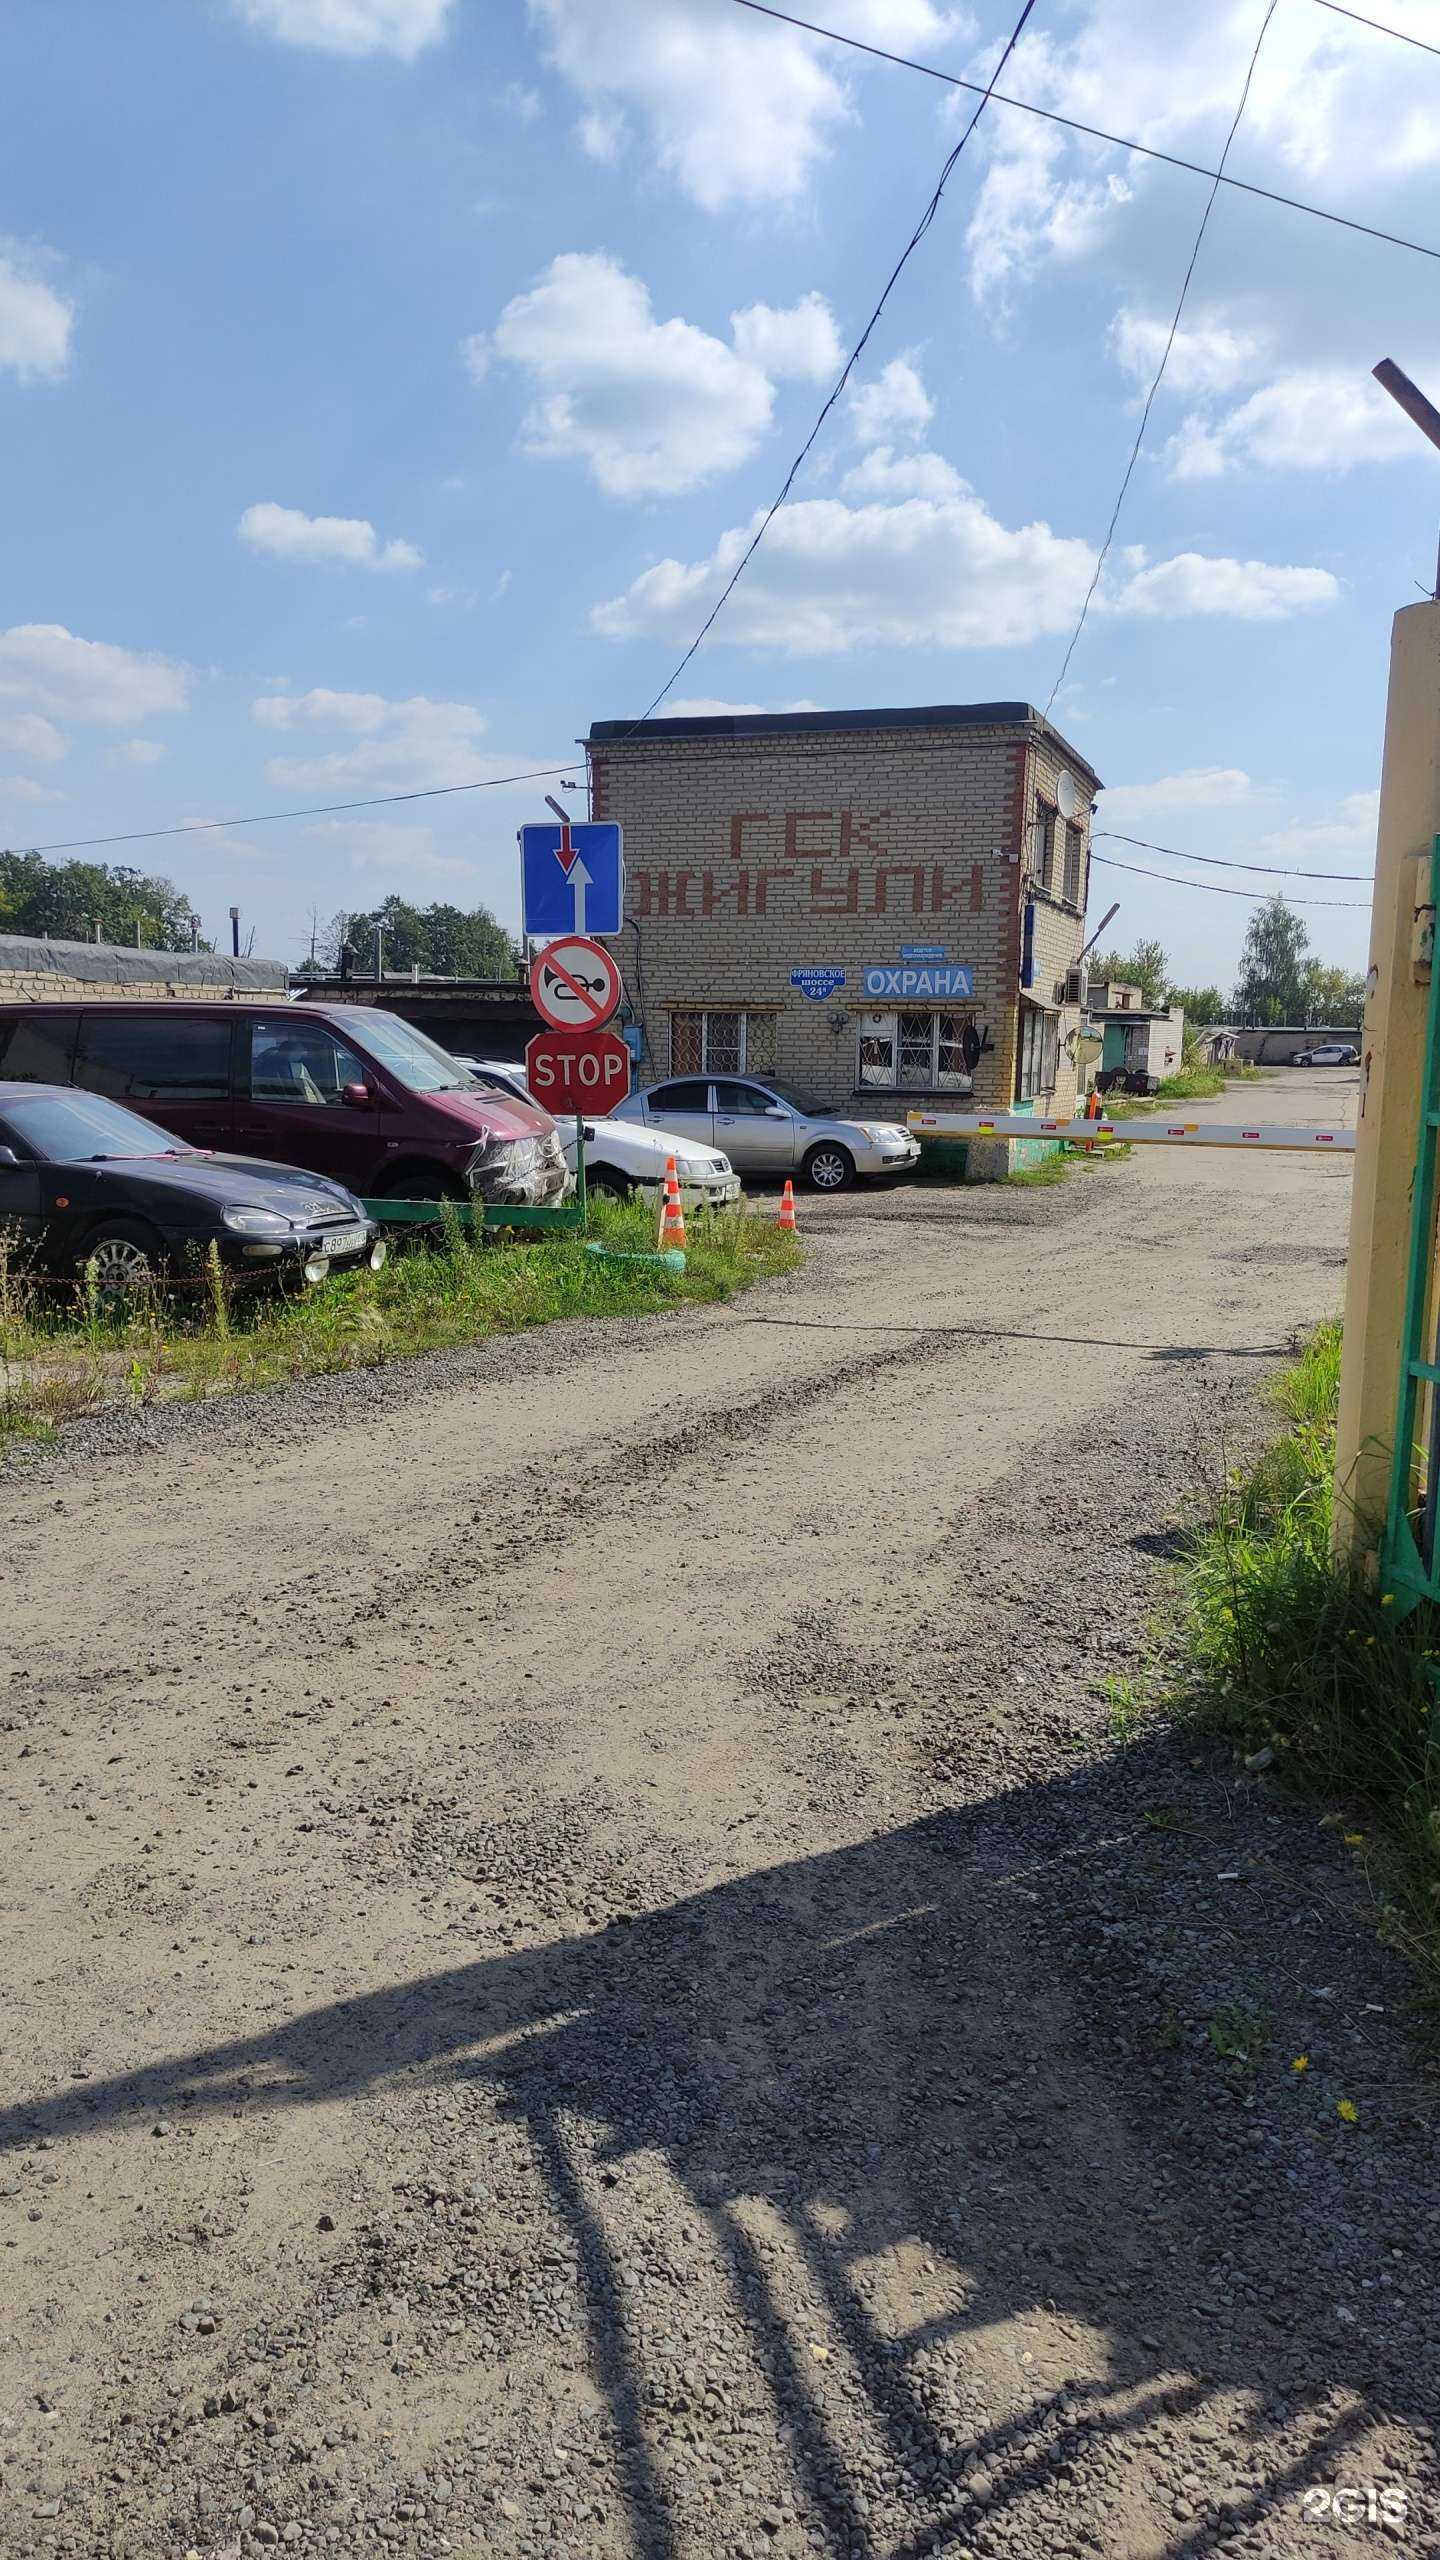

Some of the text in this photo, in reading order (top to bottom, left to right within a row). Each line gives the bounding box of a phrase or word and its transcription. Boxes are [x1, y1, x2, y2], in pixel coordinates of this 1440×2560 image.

[730, 811, 891, 859] ГСК
[633, 865, 984, 916] ЖИГУЛИ
[791, 969, 846, 978] ФРЯНОВСКОЕ
[867, 970, 970, 994] ОХРАНА
[535, 1053, 623, 1086] STOP
